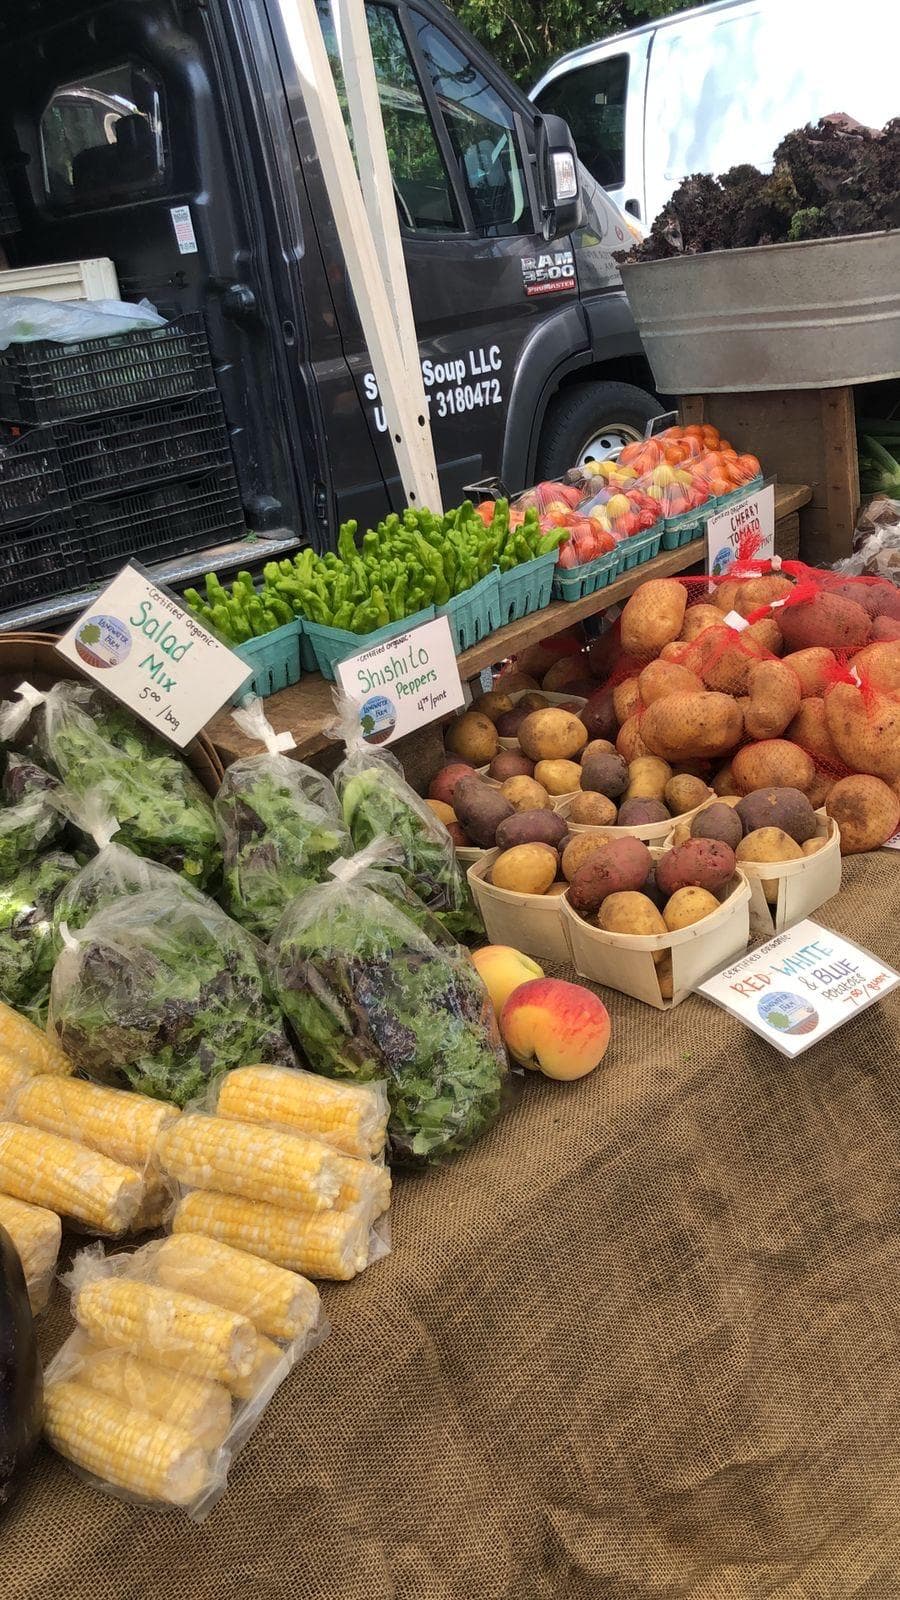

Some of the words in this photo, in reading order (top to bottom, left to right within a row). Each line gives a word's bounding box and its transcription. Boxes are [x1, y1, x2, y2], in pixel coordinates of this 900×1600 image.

[521, 251, 573, 271] RAM
[522, 264, 575, 283] 3500
[422, 360, 466, 386] Soup
[469, 345, 502, 376] LLC
[436, 378, 502, 417] 3180472
[727, 517, 760, 547] TOMATO
[730, 502, 759, 532] CHERRY
[148, 588, 184, 621] Certified
[129, 600, 194, 663] Salad
[138, 654, 177, 693] Mix
[357, 645, 429, 694] Shishito
[395, 669, 437, 700] Peppers
[769, 941, 834, 977] WHITE
[798, 975, 818, 991] &
[811, 959, 859, 986] BLUE
